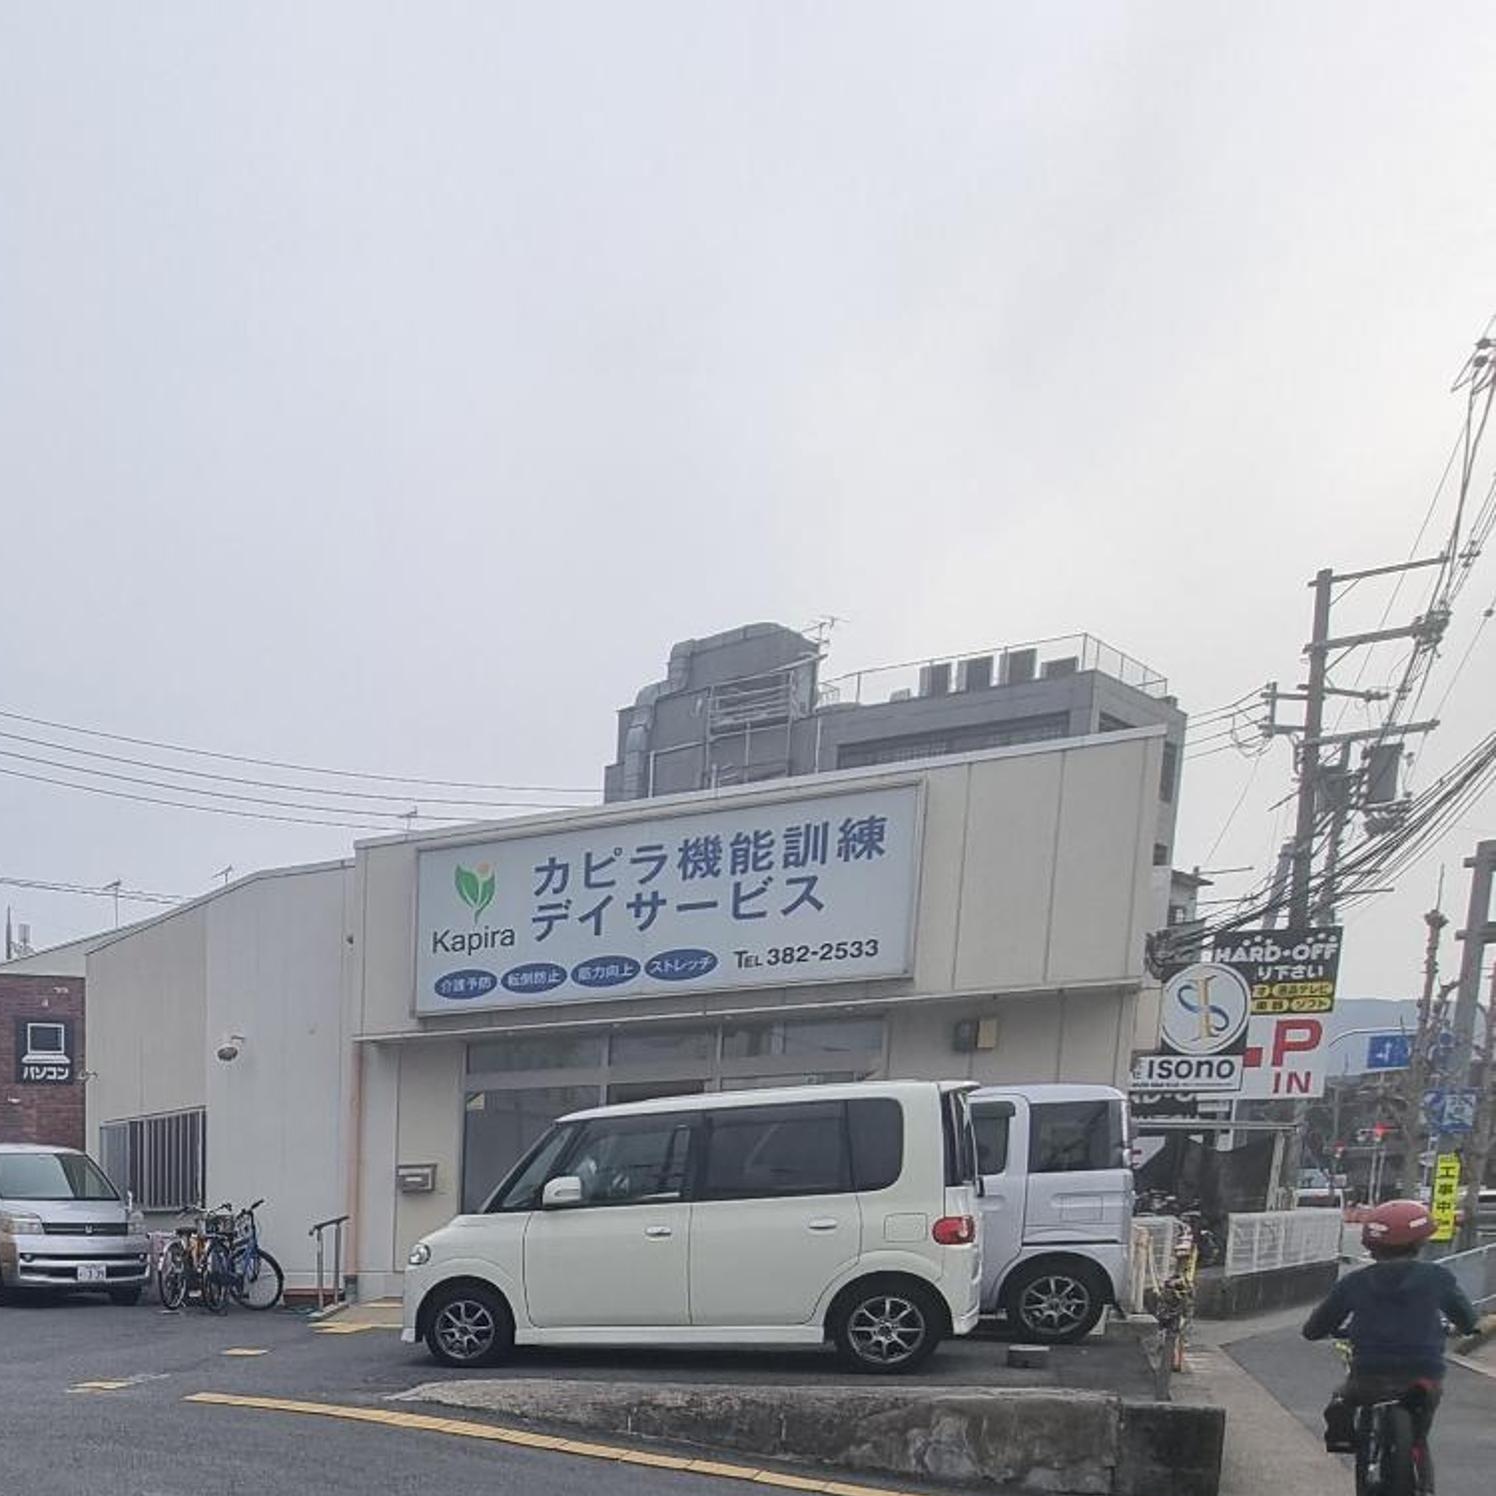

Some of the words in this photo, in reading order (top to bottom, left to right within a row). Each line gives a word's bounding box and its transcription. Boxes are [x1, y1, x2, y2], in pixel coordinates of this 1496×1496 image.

[534, 814, 888, 897] カピラ機能訓練
[532, 874, 825, 942] デイサービス
[432, 926, 515, 956] Kapira
[766, 938, 879, 966] 382-2533
[650, 955, 714, 974] ストレッチ
[1272, 1018, 1323, 1068] P
[23, 1066, 69, 1080] パソコン
[1272, 1071, 1311, 1094] IN
